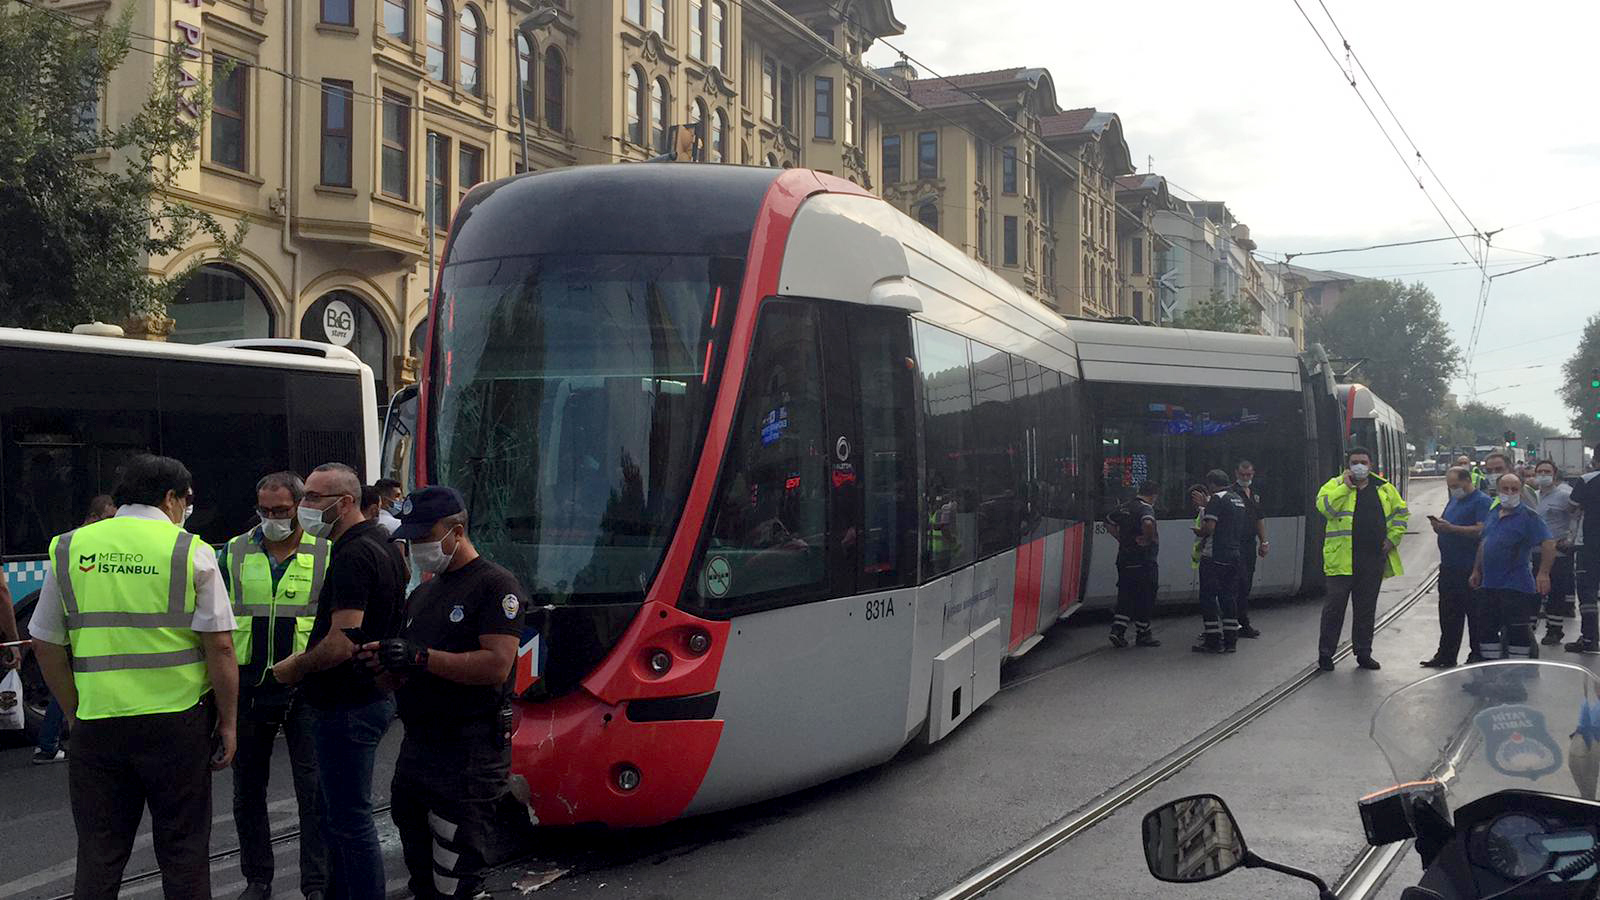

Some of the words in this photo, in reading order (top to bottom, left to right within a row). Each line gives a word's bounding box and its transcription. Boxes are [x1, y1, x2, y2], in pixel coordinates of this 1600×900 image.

[327, 308, 352, 331] B&G
[331, 330, 347, 338] store
[98, 553, 144, 563] METRO
[98, 562, 160, 575] İSTANBUL
[865, 597, 895, 621] 831A
